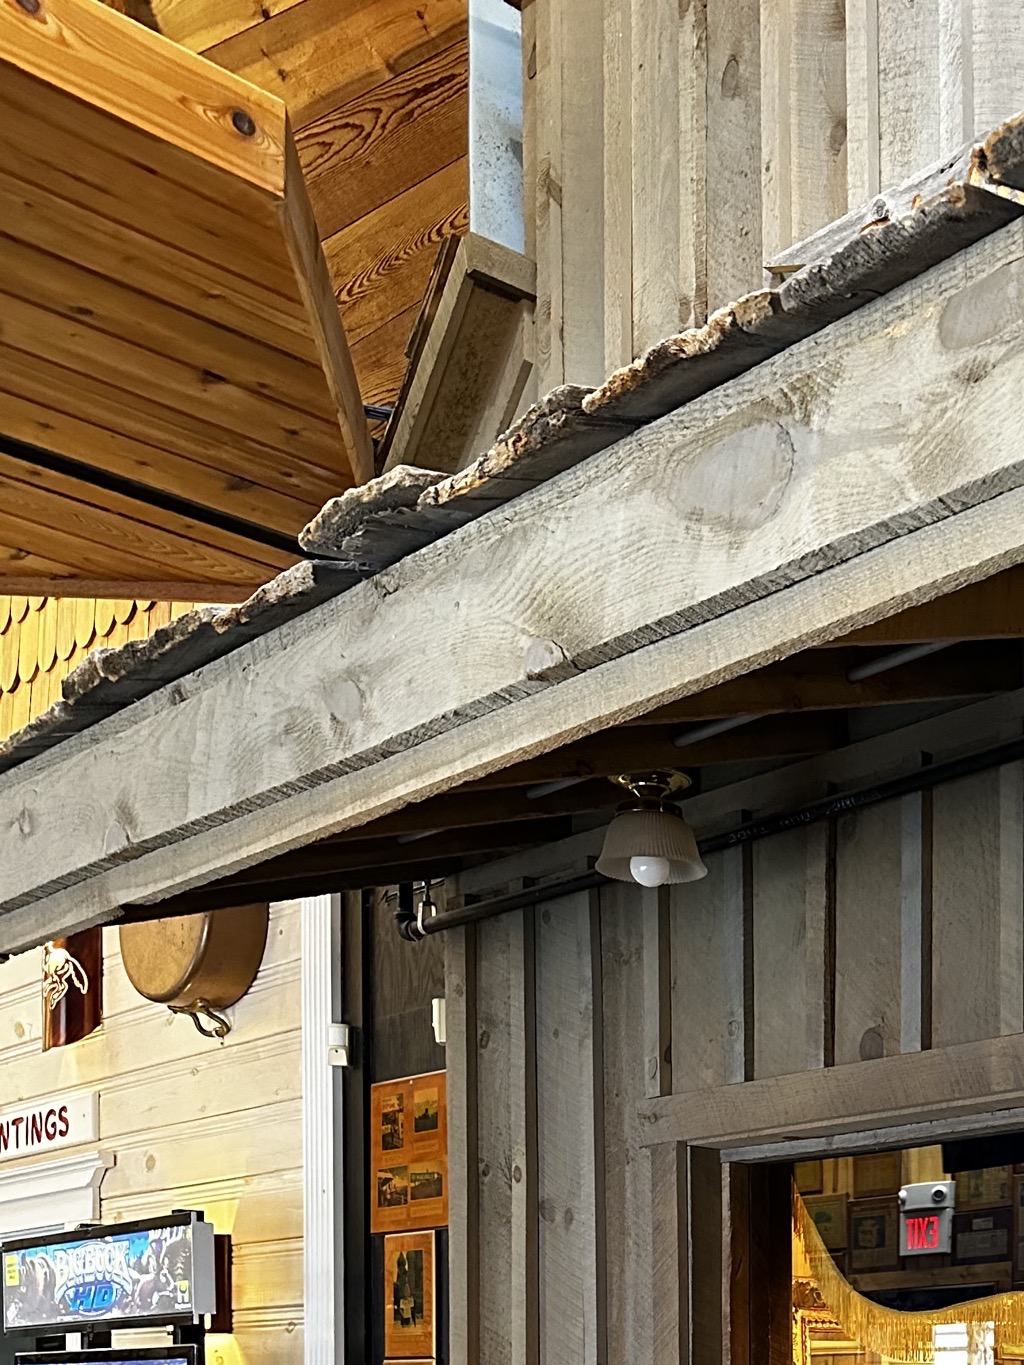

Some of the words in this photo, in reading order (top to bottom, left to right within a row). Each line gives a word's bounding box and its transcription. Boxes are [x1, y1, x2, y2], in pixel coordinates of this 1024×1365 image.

[54, 1246, 86, 1283] BIG
[86, 1240, 131, 1285] BUCK
[69, 1284, 116, 1311] HD
